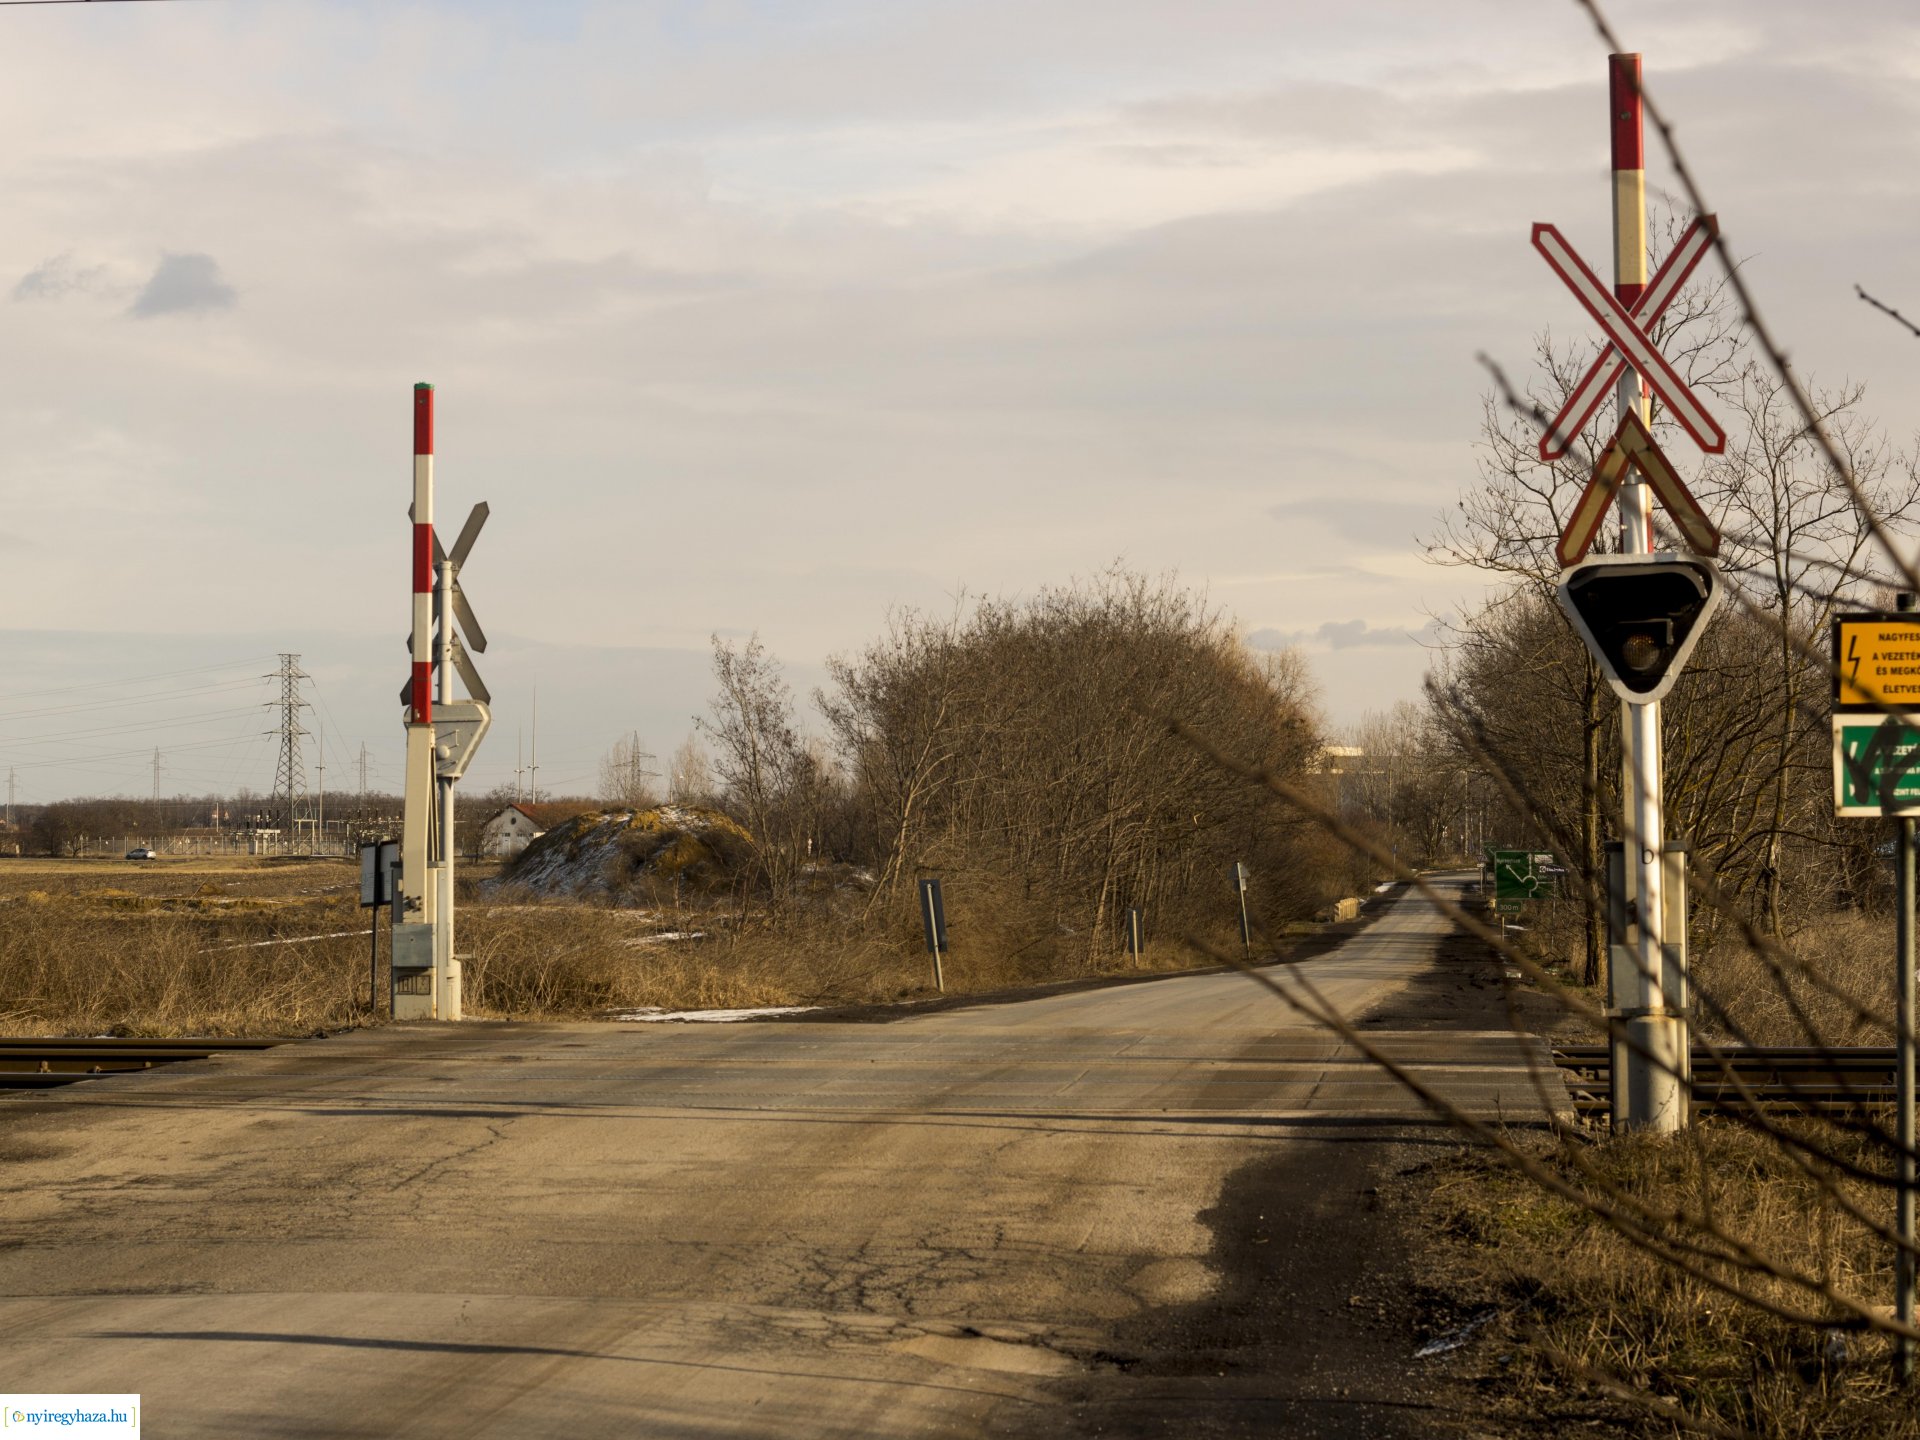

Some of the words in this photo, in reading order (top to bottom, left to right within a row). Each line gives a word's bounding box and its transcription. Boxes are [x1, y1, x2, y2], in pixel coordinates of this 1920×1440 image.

[1878, 632, 1920, 642] NAGYFES
[1872, 652, 1879, 661] A
[1876, 665, 1887, 676] ÉS
